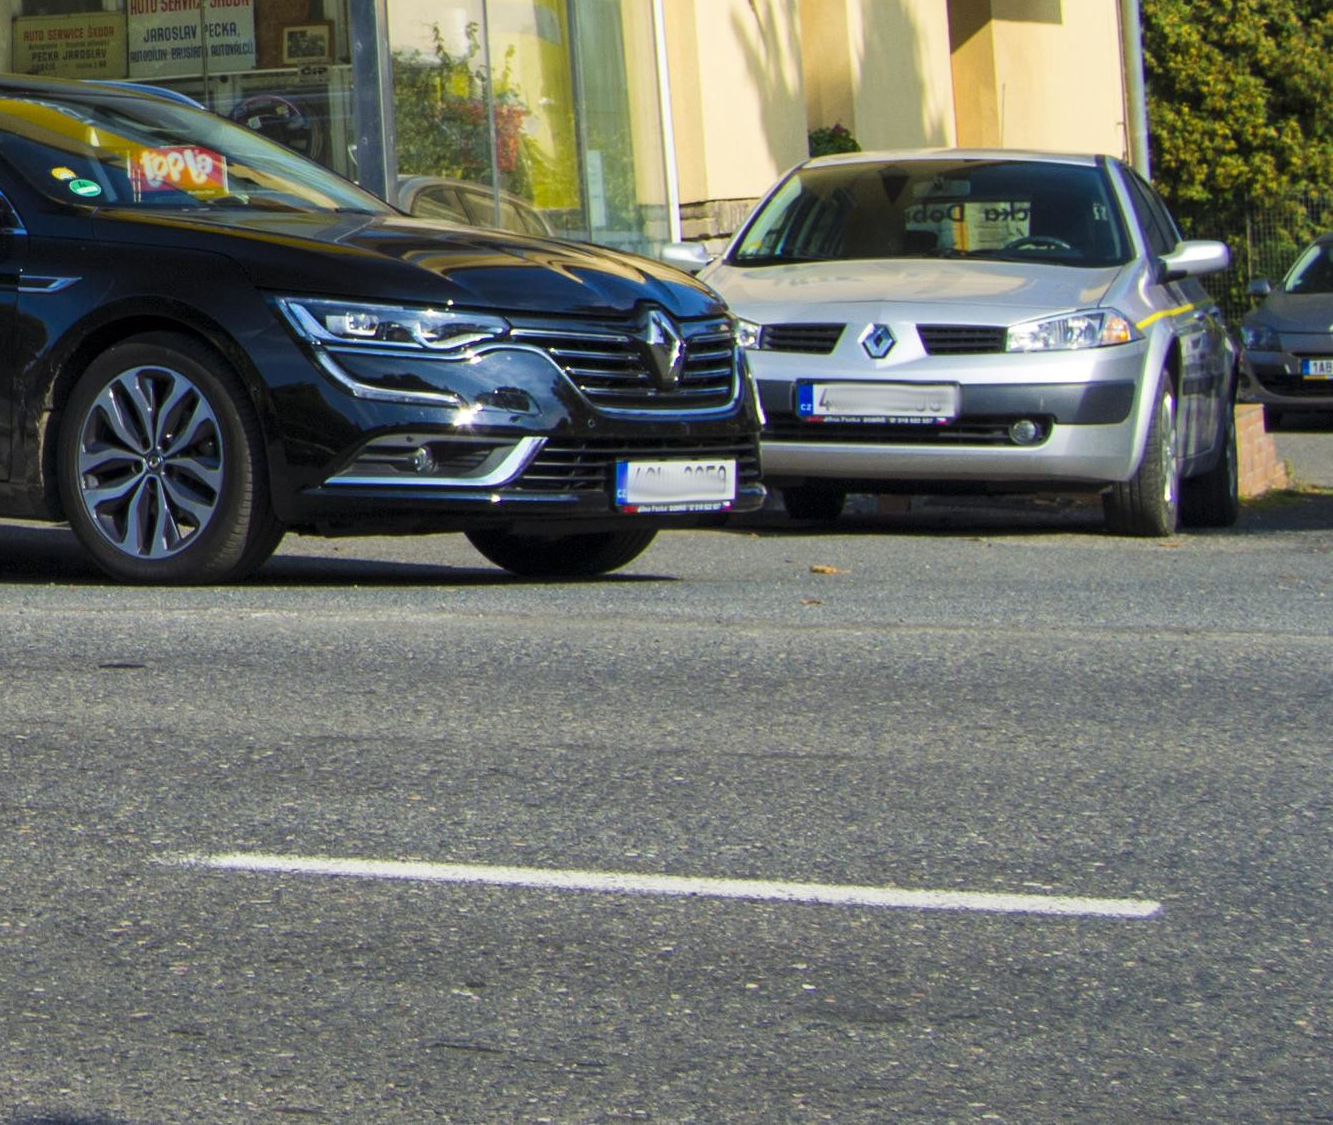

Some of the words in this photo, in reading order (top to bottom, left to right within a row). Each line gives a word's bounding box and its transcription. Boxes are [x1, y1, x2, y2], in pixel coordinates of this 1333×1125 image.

[143, 24, 198, 43] JAROSLAV
[800, 403, 812, 411] CZ
[616, 488, 627, 499] CZ
